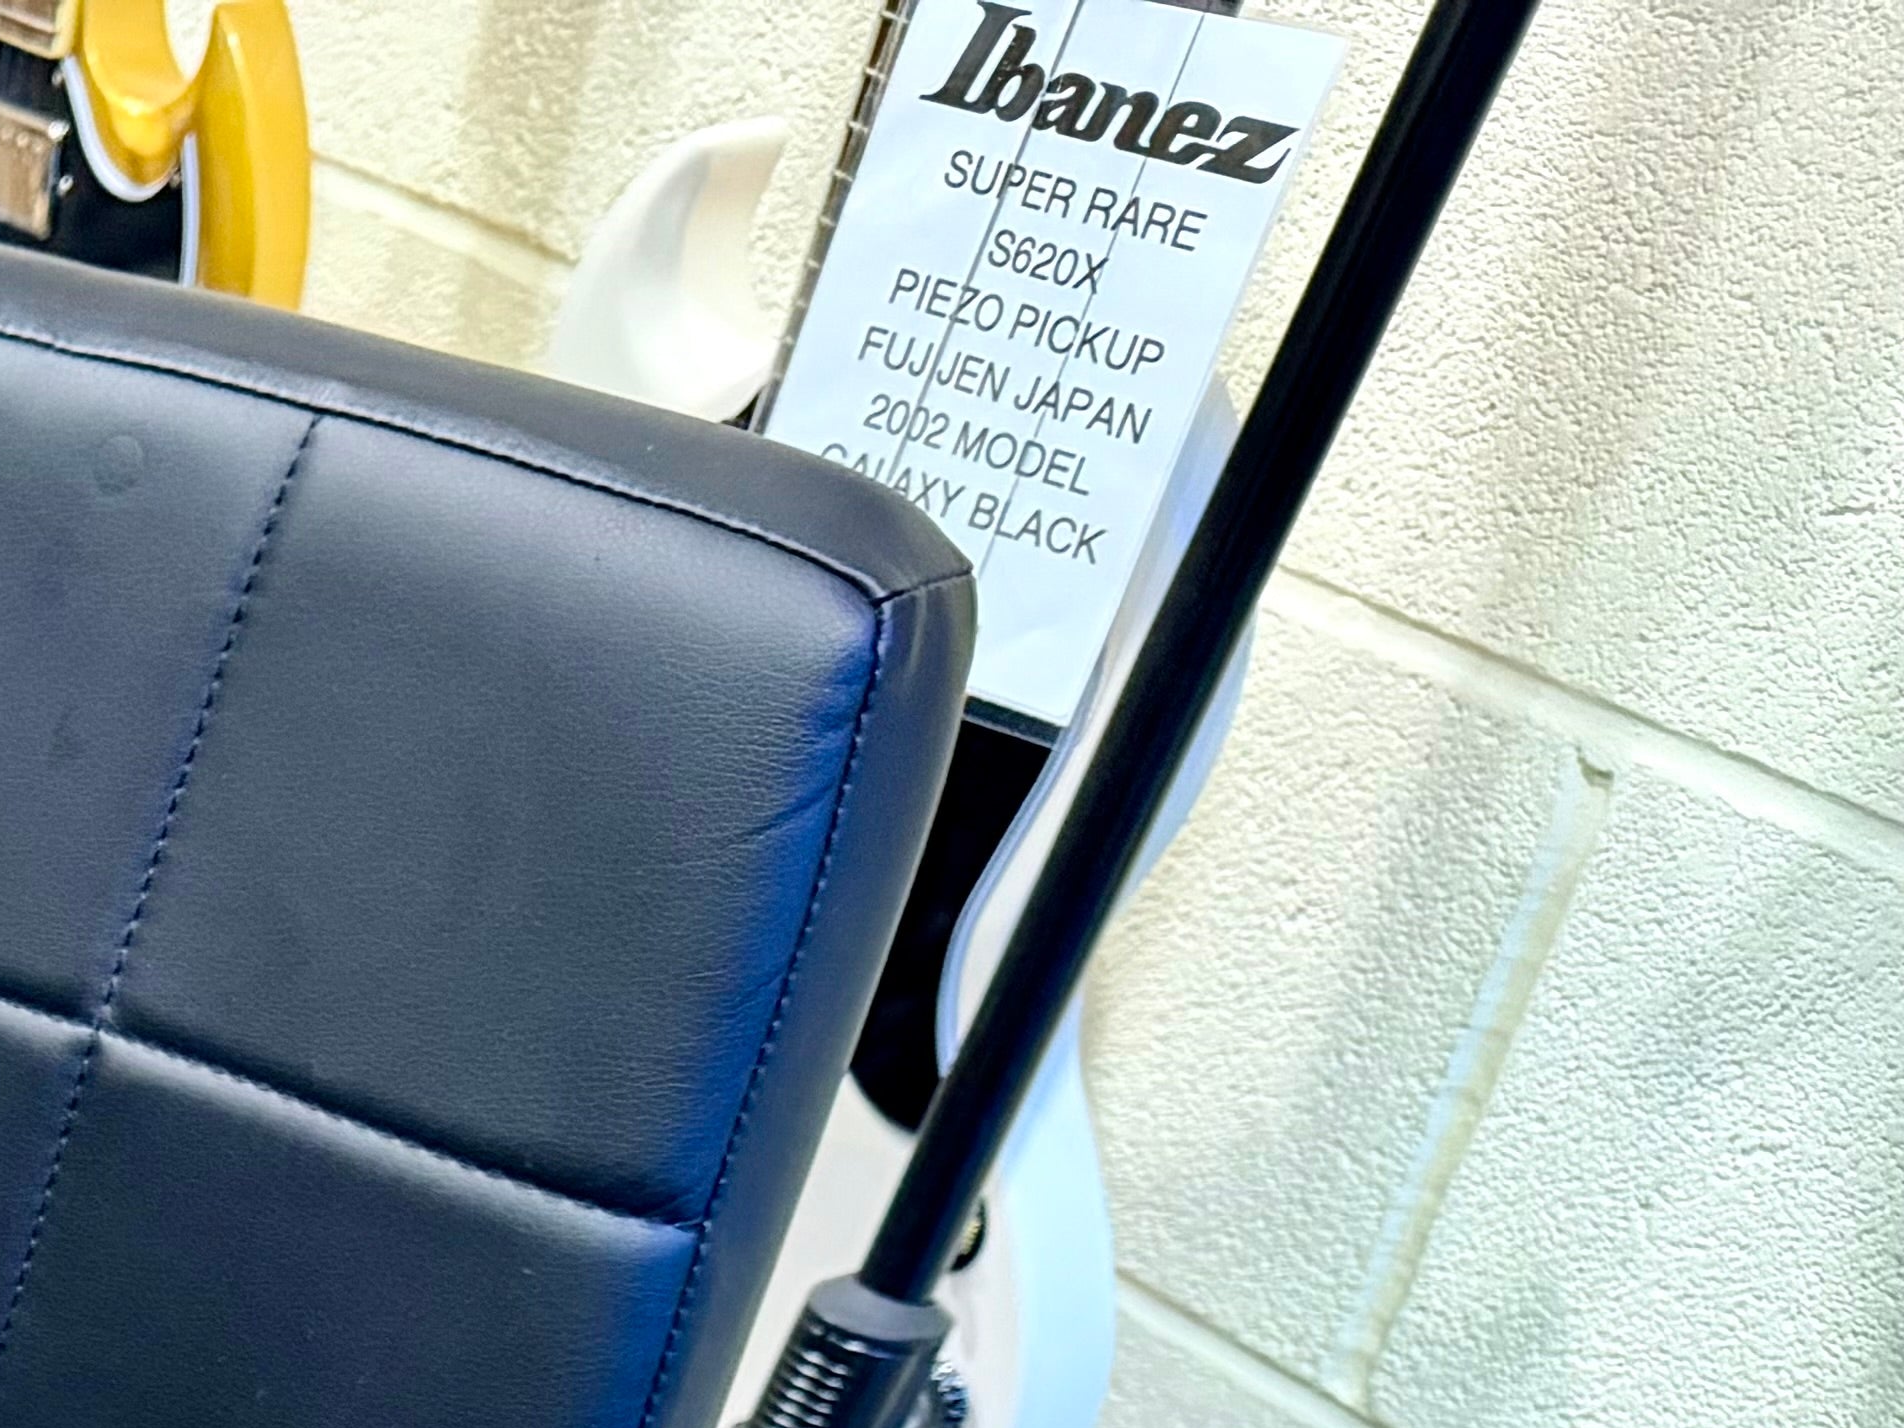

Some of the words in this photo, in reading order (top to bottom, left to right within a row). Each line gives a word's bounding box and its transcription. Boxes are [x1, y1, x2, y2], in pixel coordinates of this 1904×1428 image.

[918, 0, 1301, 186] Ibanez
[943, 148, 1078, 220] SUPER
[1082, 186, 1209, 252] RARE
[987, 229, 1110, 296] S620X
[888, 267, 1004, 333] PIEZO
[1008, 303, 1165, 377] PICKUP
[857, 326, 1010, 402] FUJJEN
[1013, 375, 1153, 445] JAPAN
[863, 393, 952, 449] 2002
[951, 420, 1092, 497] MODEL
[967, 492, 1109, 566] BLACK
